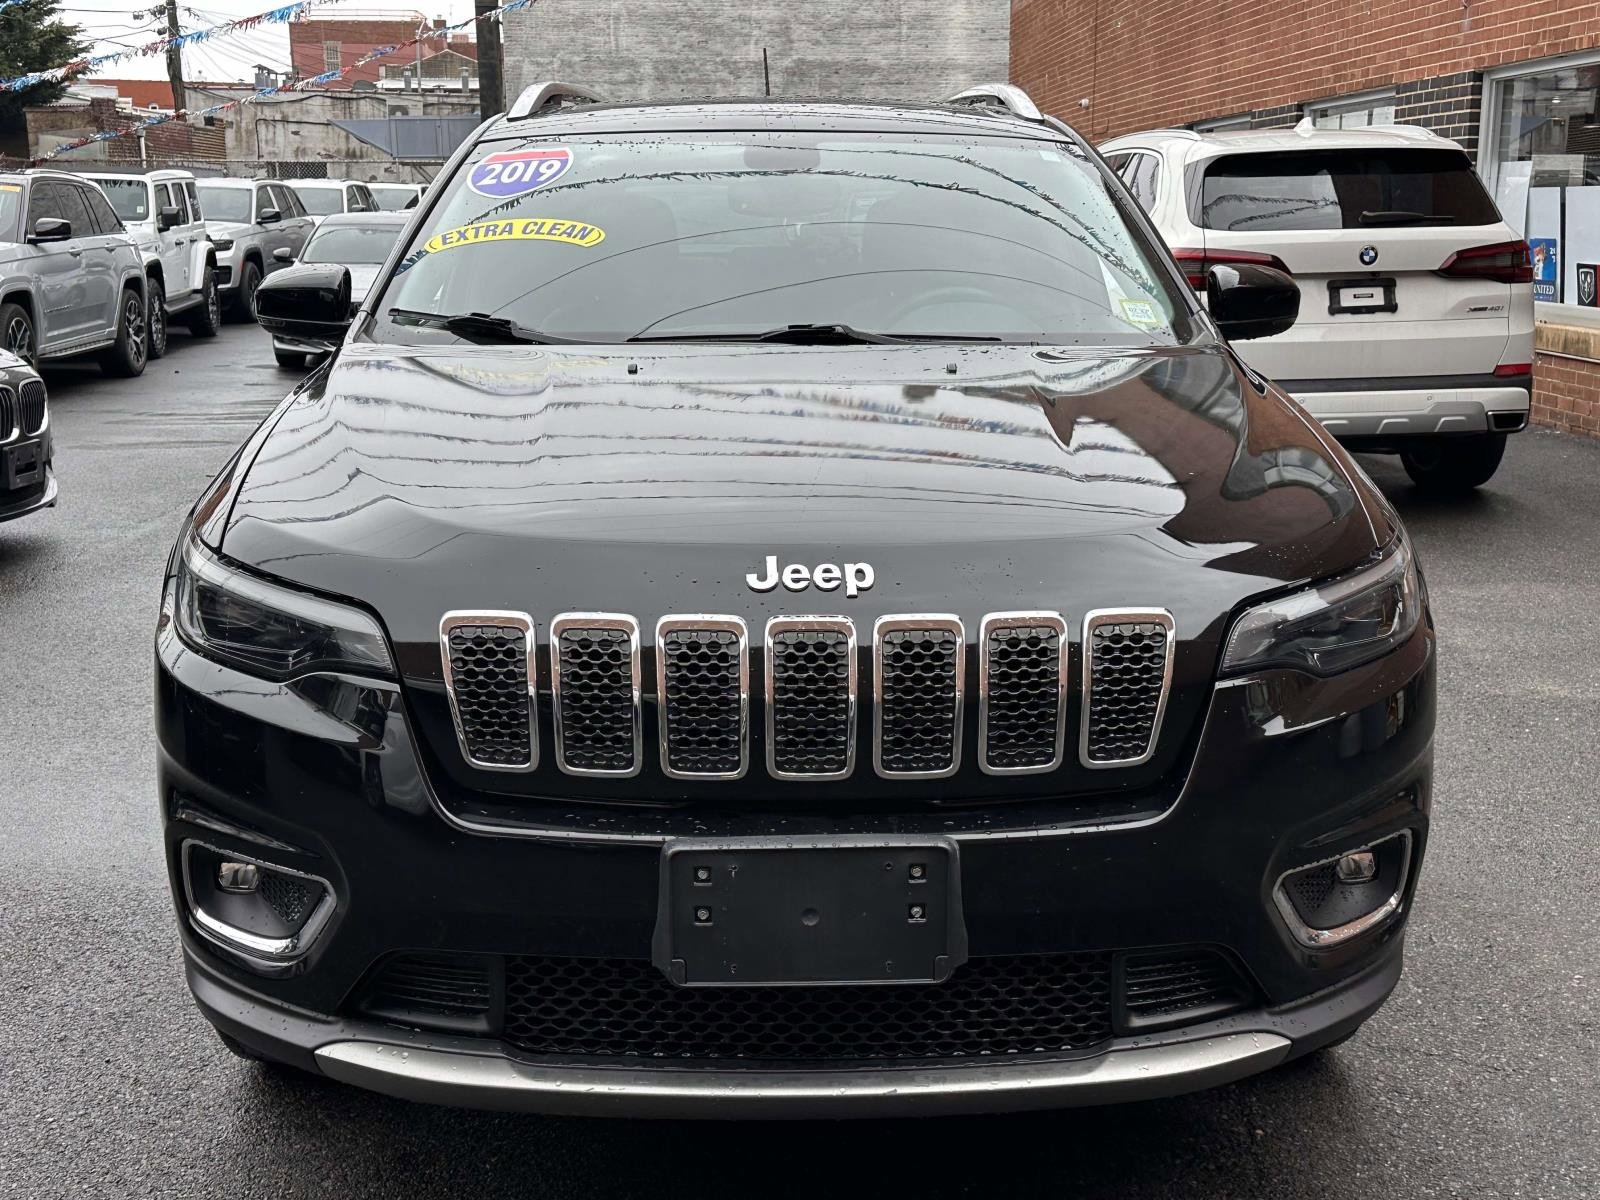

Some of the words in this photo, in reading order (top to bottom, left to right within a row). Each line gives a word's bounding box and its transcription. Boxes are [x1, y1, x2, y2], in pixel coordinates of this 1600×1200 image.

[476, 159, 562, 186] 2019
[441, 222, 514, 246] EXTRA
[521, 221, 595, 241] CLEAN
[1533, 284, 1555, 295] UNITED
[745, 555, 875, 599] Jeep
